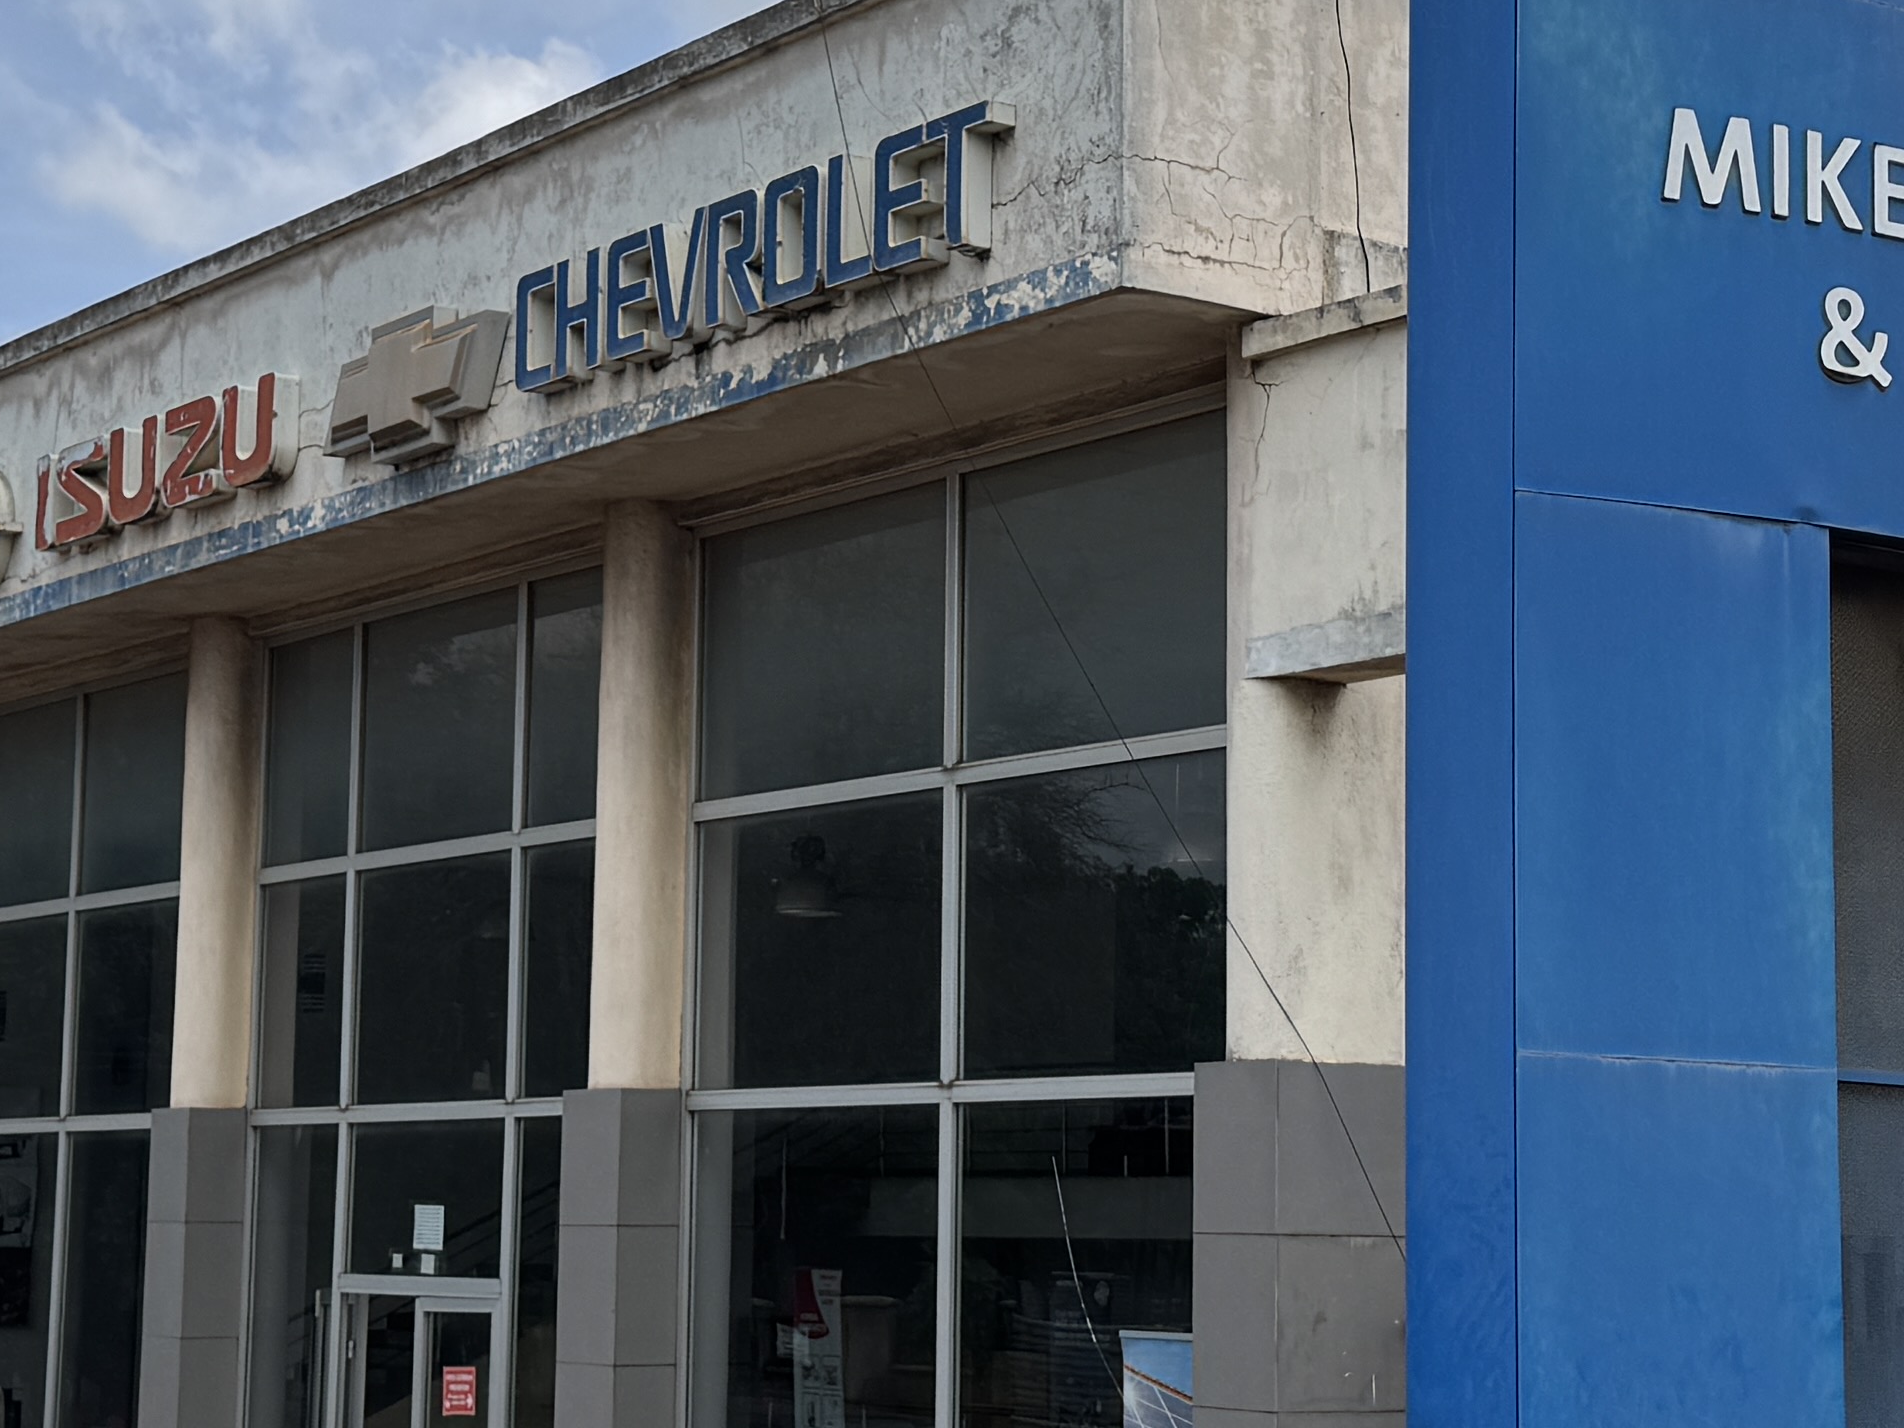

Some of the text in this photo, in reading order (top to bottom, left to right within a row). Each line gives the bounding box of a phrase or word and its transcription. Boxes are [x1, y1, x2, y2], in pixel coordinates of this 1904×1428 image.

[514, 100, 999, 394] CHEVROLET
[1819, 286, 1893, 391] &
[35, 372, 284, 551] ISUZU
